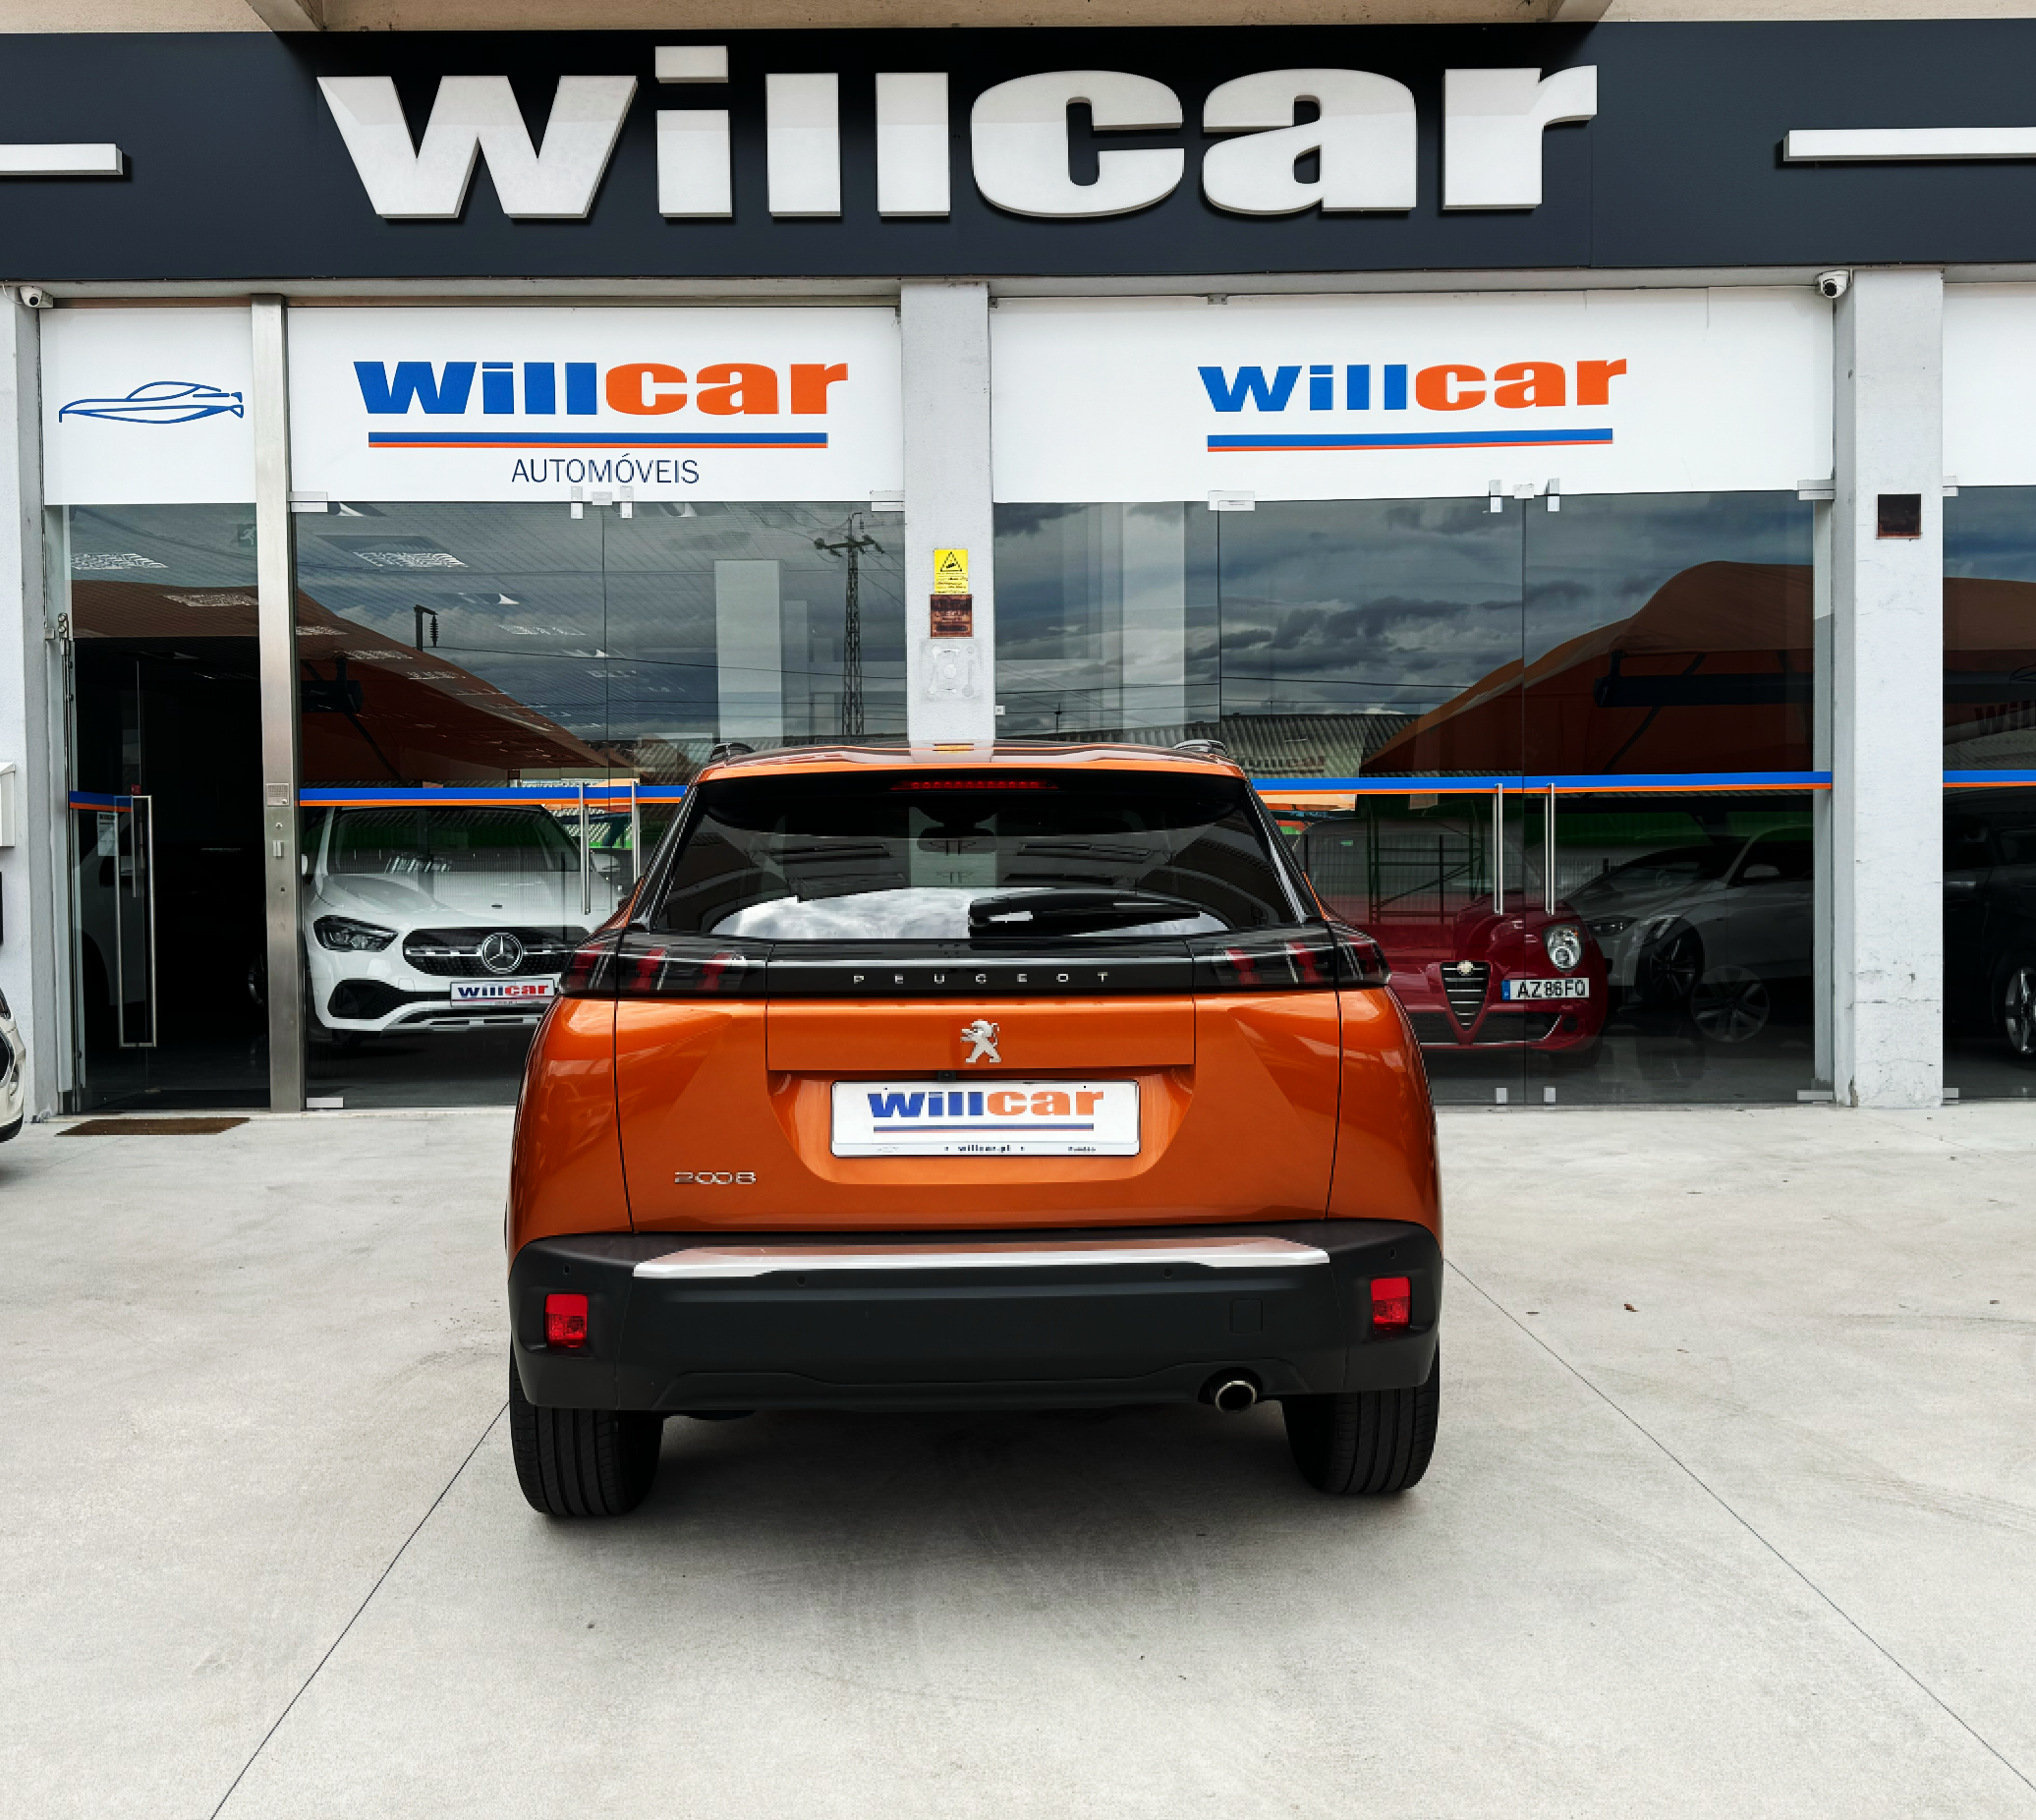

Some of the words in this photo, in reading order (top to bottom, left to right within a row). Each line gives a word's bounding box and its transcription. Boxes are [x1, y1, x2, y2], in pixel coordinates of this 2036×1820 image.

[317, 44, 1598, 222] willcar
[354, 361, 848, 415] willcar
[1198, 359, 1626, 412] willcar
[511, 453, 700, 483] AUTOMÓVEIS
[458, 985, 549, 997] willcar
[853, 971, 1109, 984] PEUGEOT
[868, 1091, 1104, 1117] willcar
[674, 1171, 757, 1185] 2008
